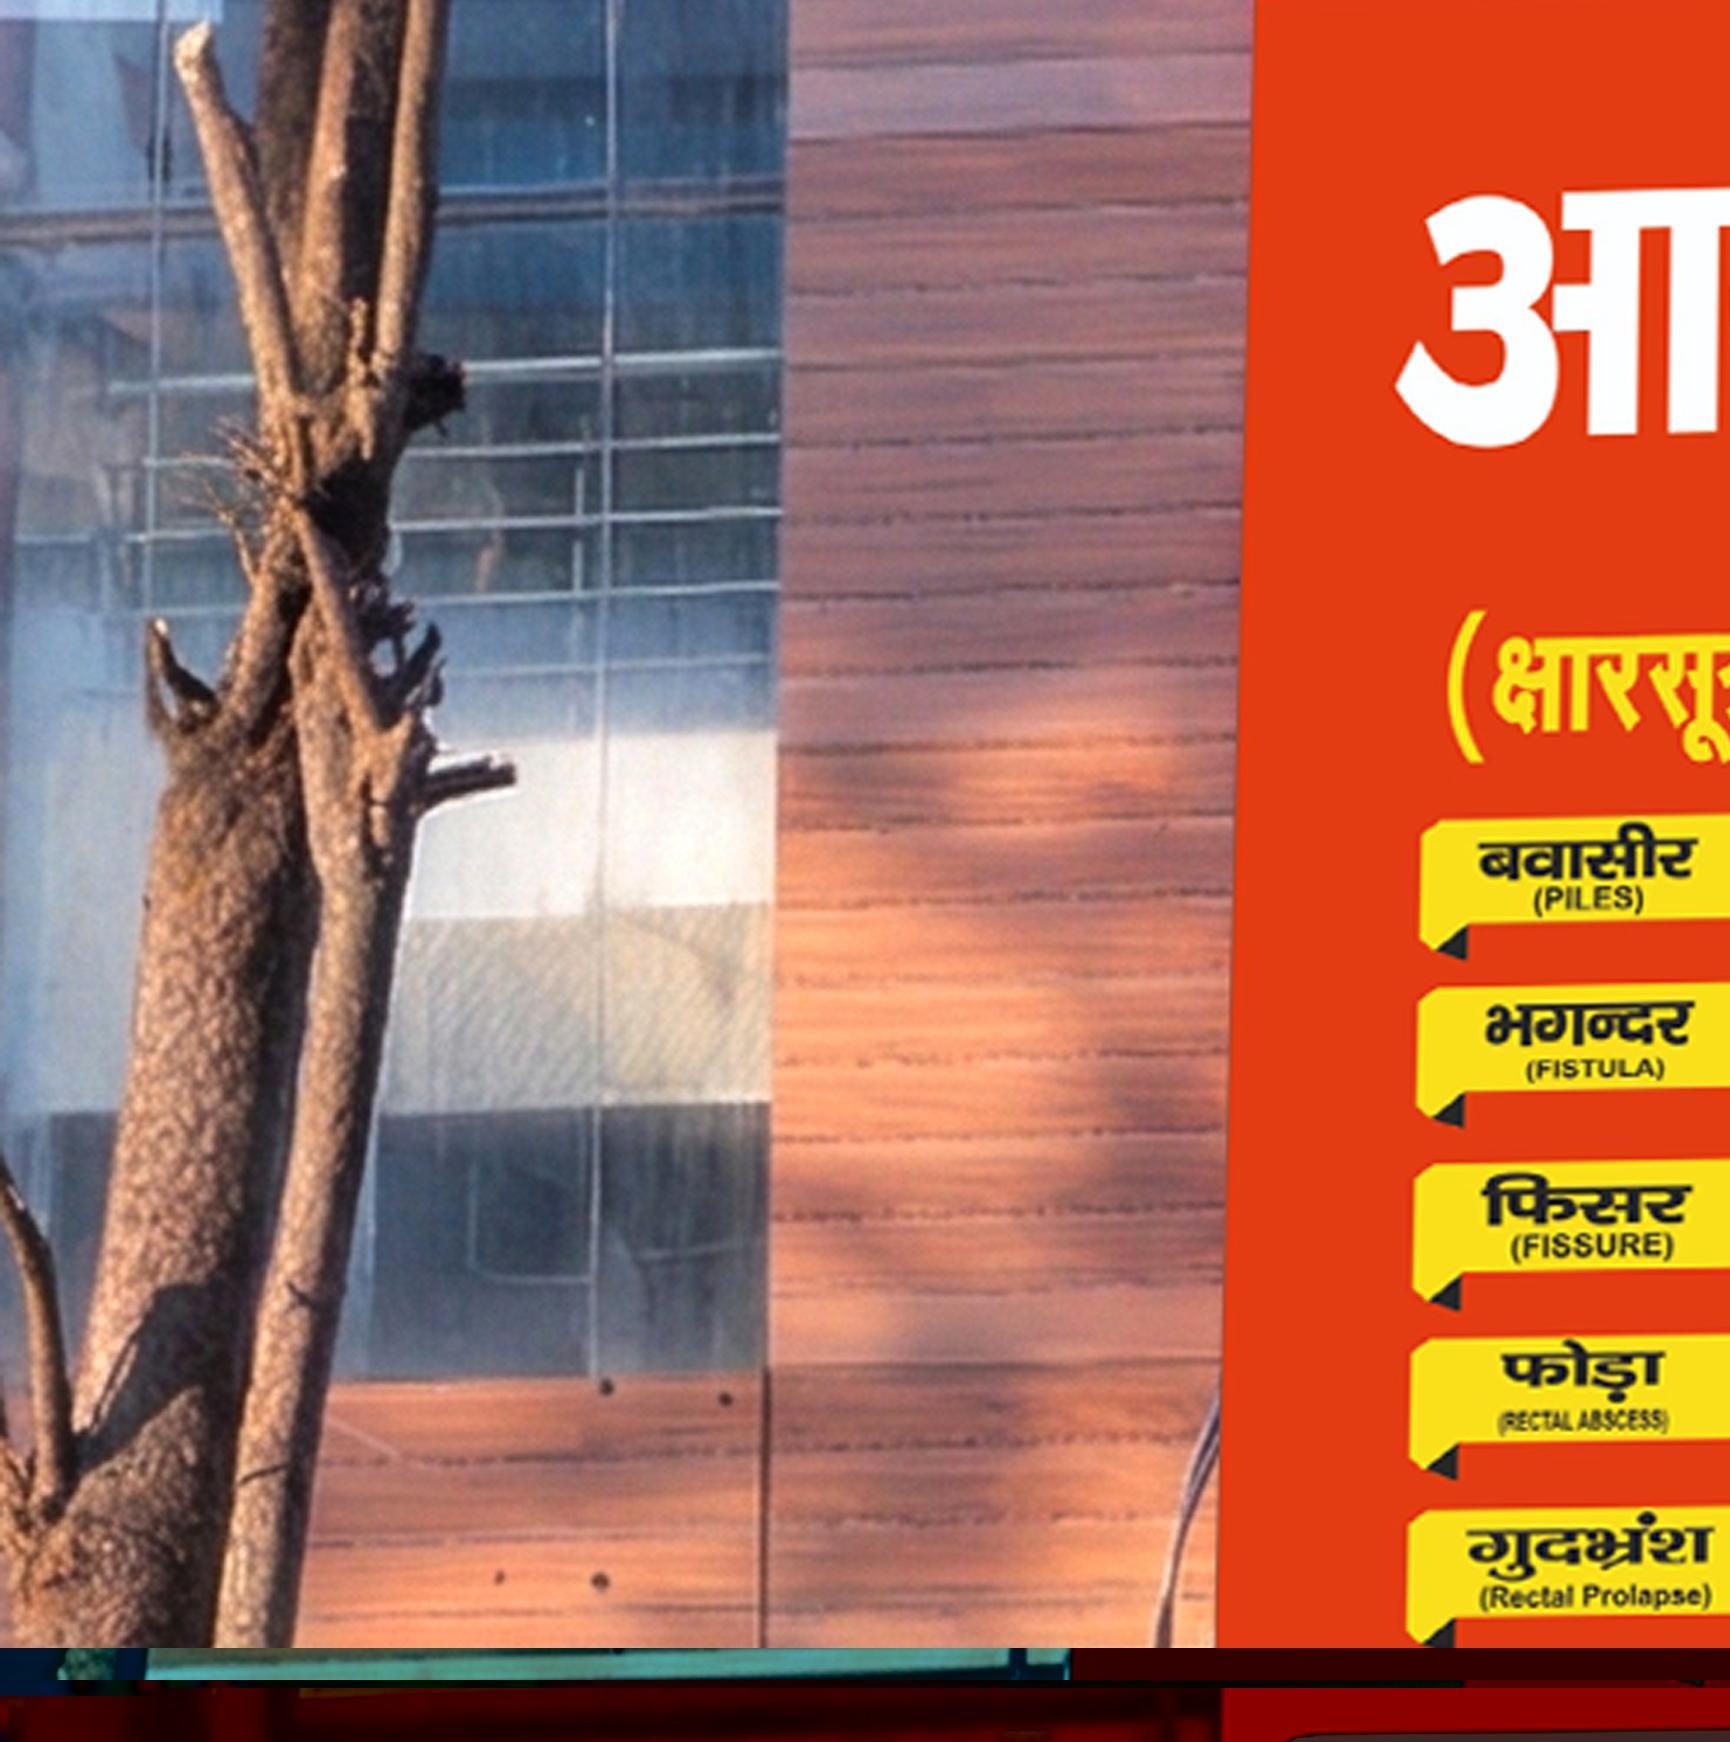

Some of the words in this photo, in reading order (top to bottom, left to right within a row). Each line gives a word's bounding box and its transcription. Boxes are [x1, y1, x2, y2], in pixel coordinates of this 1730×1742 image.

[1479, 823, 1698, 882] बवासीर
[1533, 885, 1645, 916] (PILES)
[1485, 1001, 1695, 1046] भगन्दर
[1526, 1057, 1665, 1082] (FISTULA)
[1482, 1173, 1693, 1224] फिसर
[1511, 1233, 1674, 1263] (FISSURE)
[1502, 1340, 1665, 1404] फोड़ा
[1499, 1410, 1575, 1435] (RECTAL
[1578, 1408, 1669, 1434] ABSCESS)
[1466, 1511, 1715, 1580] गुदभ्रंश
[1480, 1585, 1574, 1612] (Rectal
[1582, 1583, 1712, 1612] Prolapse)
